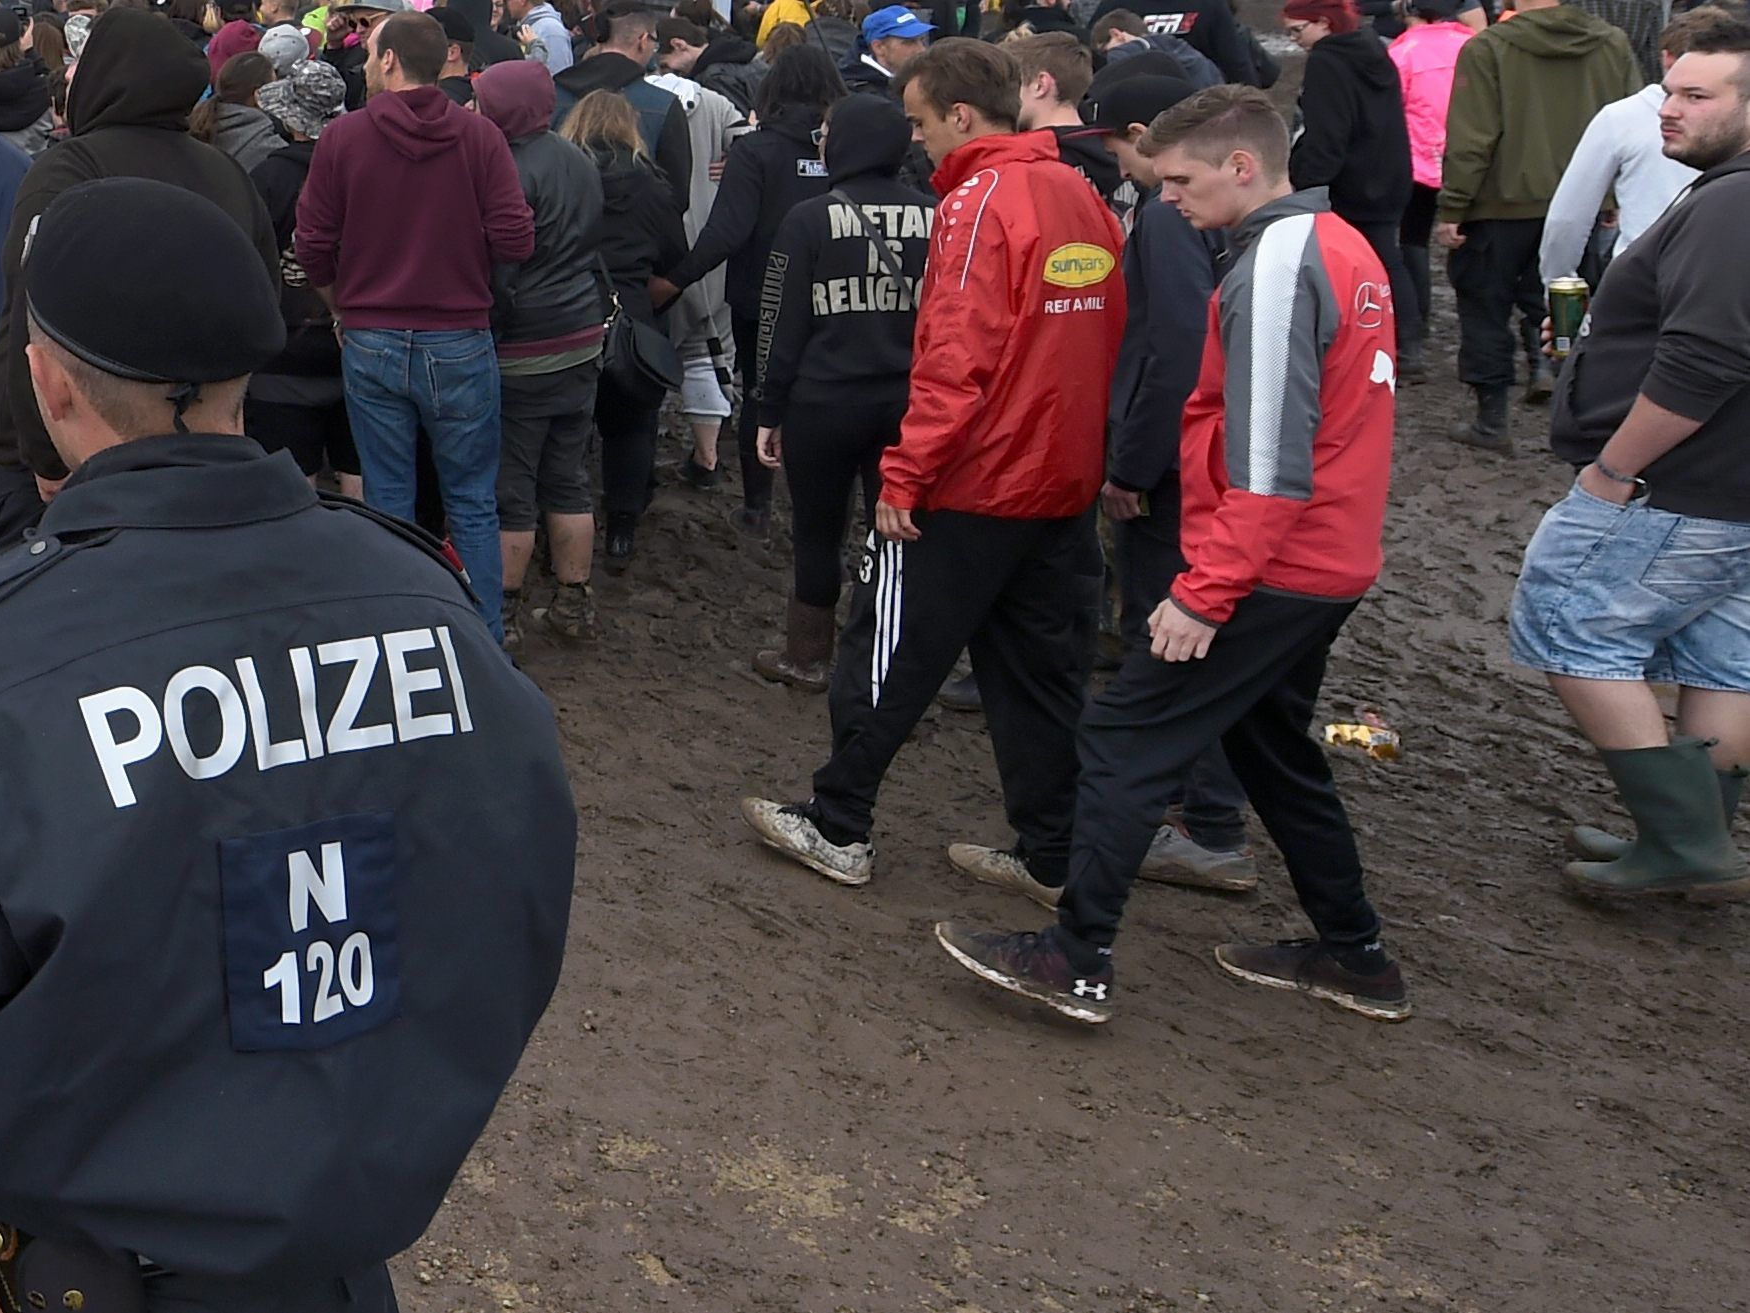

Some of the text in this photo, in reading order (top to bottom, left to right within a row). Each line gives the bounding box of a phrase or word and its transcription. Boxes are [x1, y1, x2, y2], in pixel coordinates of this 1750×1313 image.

[868, 240, 903, 275] IS
[1073, 298, 1083, 311] A
[78, 626, 474, 808] POLIZEI
[288, 841, 347, 933] N
[263, 932, 374, 1024] 120
